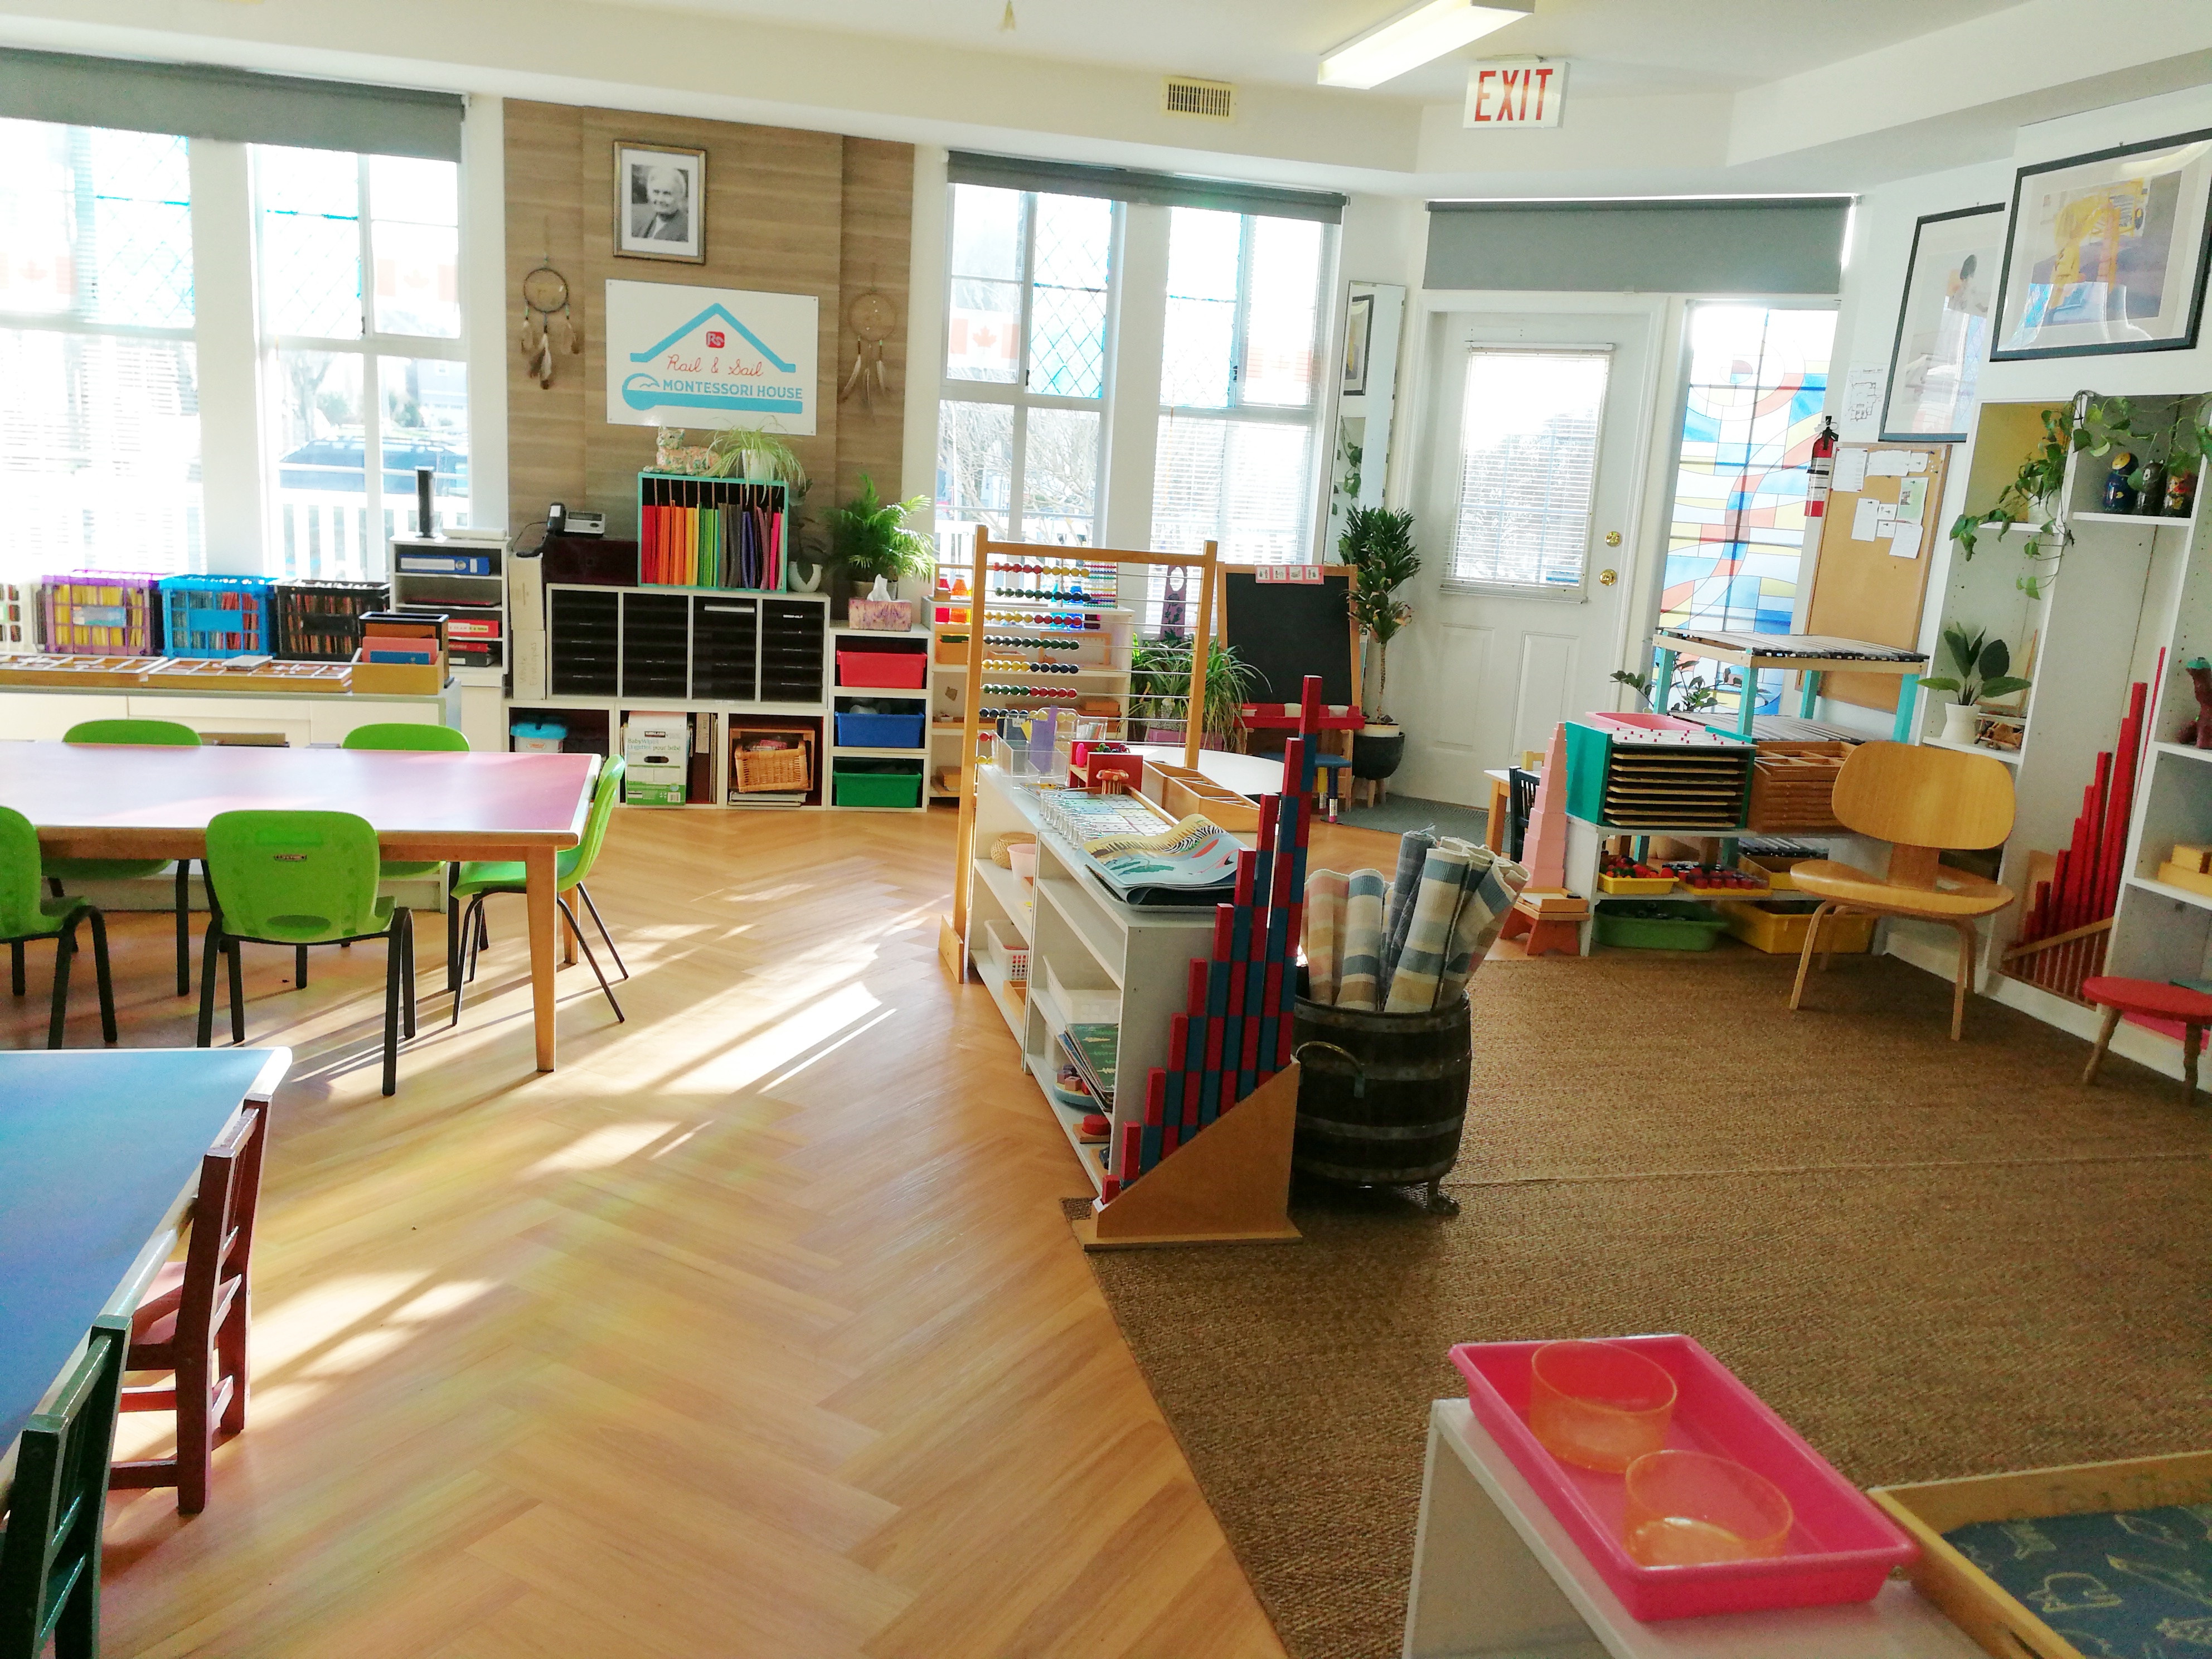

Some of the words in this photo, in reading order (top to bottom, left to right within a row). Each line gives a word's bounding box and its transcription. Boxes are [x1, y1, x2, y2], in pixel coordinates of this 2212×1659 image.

[1474, 69, 1554, 122] EXIT
[667, 354, 702, 372] Rail
[711, 357, 719, 373] &
[728, 358, 764, 376] Sail
[663, 379, 753, 396] MONTESSORI
[757, 385, 803, 399] HOUSE
